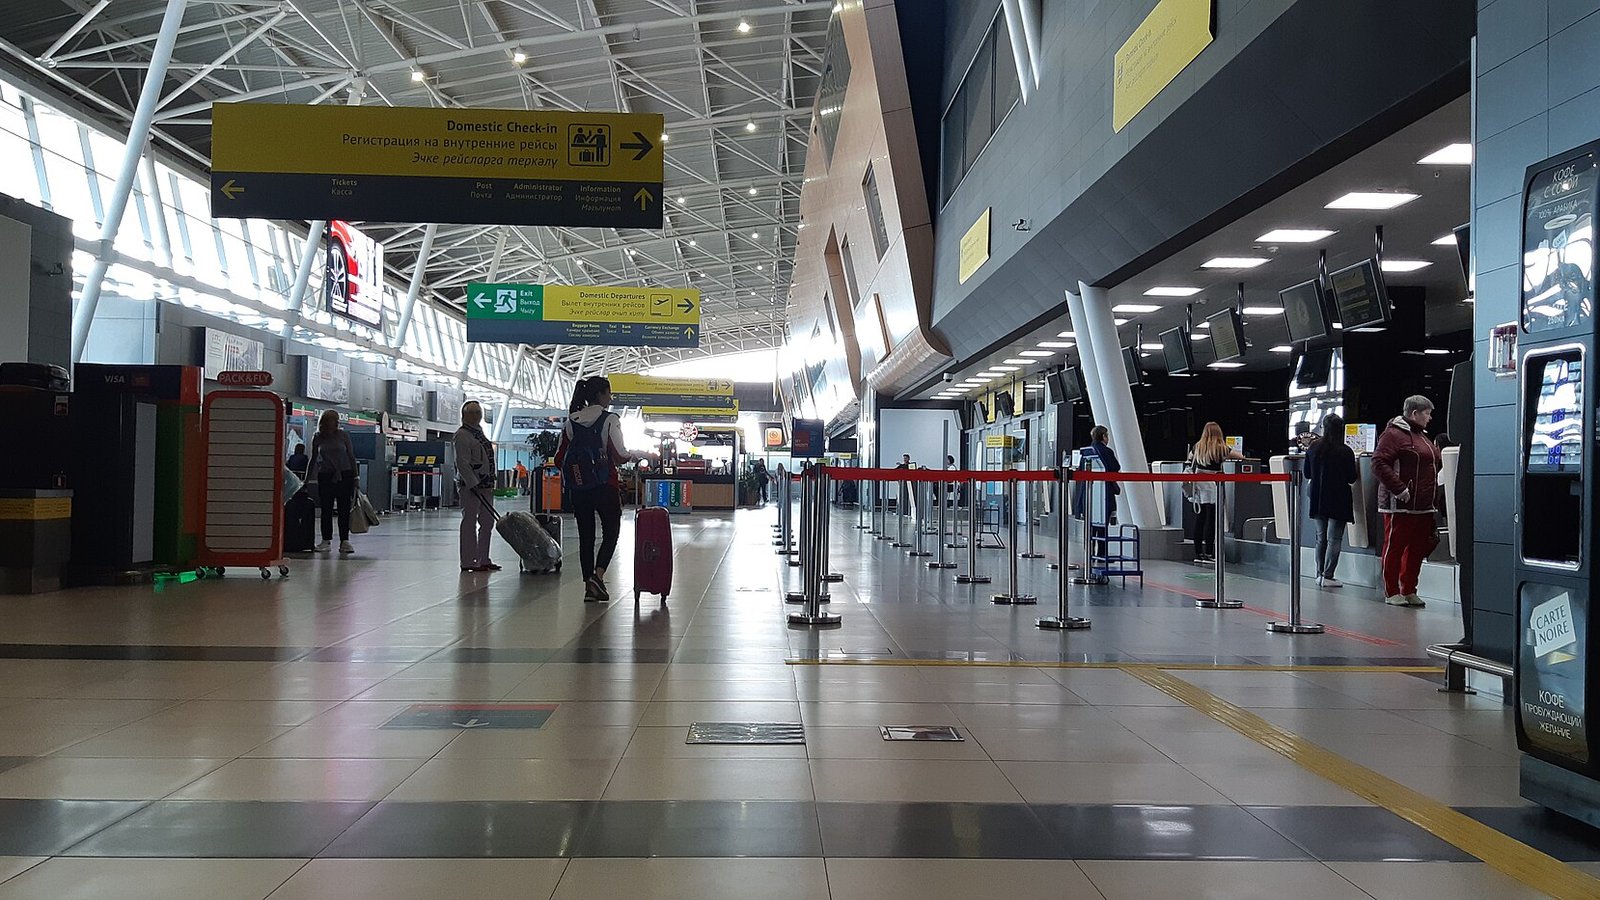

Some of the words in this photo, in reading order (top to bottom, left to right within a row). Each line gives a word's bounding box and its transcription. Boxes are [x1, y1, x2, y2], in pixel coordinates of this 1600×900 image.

[447, 120, 502, 132] Domestic
[506, 121, 558, 134] Check-in
[342, 133, 420, 149] Регистрация
[424, 138, 439, 147] на
[443, 139, 515, 152] внутренние
[520, 140, 558, 153] рейсы
[412, 152, 439, 163] Эчке
[442, 153, 503, 167] рейсларга
[1552, 164, 1576, 183] КОФЕ
[331, 178, 358, 186] Tickets
[513, 183, 563, 192] Administrator
[470, 191, 492, 199] Почта
[580, 185, 621, 193] Information
[520, 289, 533, 297] Exit
[580, 291, 609, 299] Domestic
[610, 292, 646, 300] Departures
[561, 299, 581, 307] Вылет
[104, 375, 125, 383] VISA
[219, 373, 270, 384] PACK&FLY
[1535, 604, 1567, 630] CARTE
[1538, 620, 1570, 645] NOIRE
[1538, 689, 1565, 709] КОФЕ
[1524, 702, 1582, 728] ПРОБУЖДАЮЩИЙ
[1538, 720, 1572, 741] ЖЕЛАНИЕ
